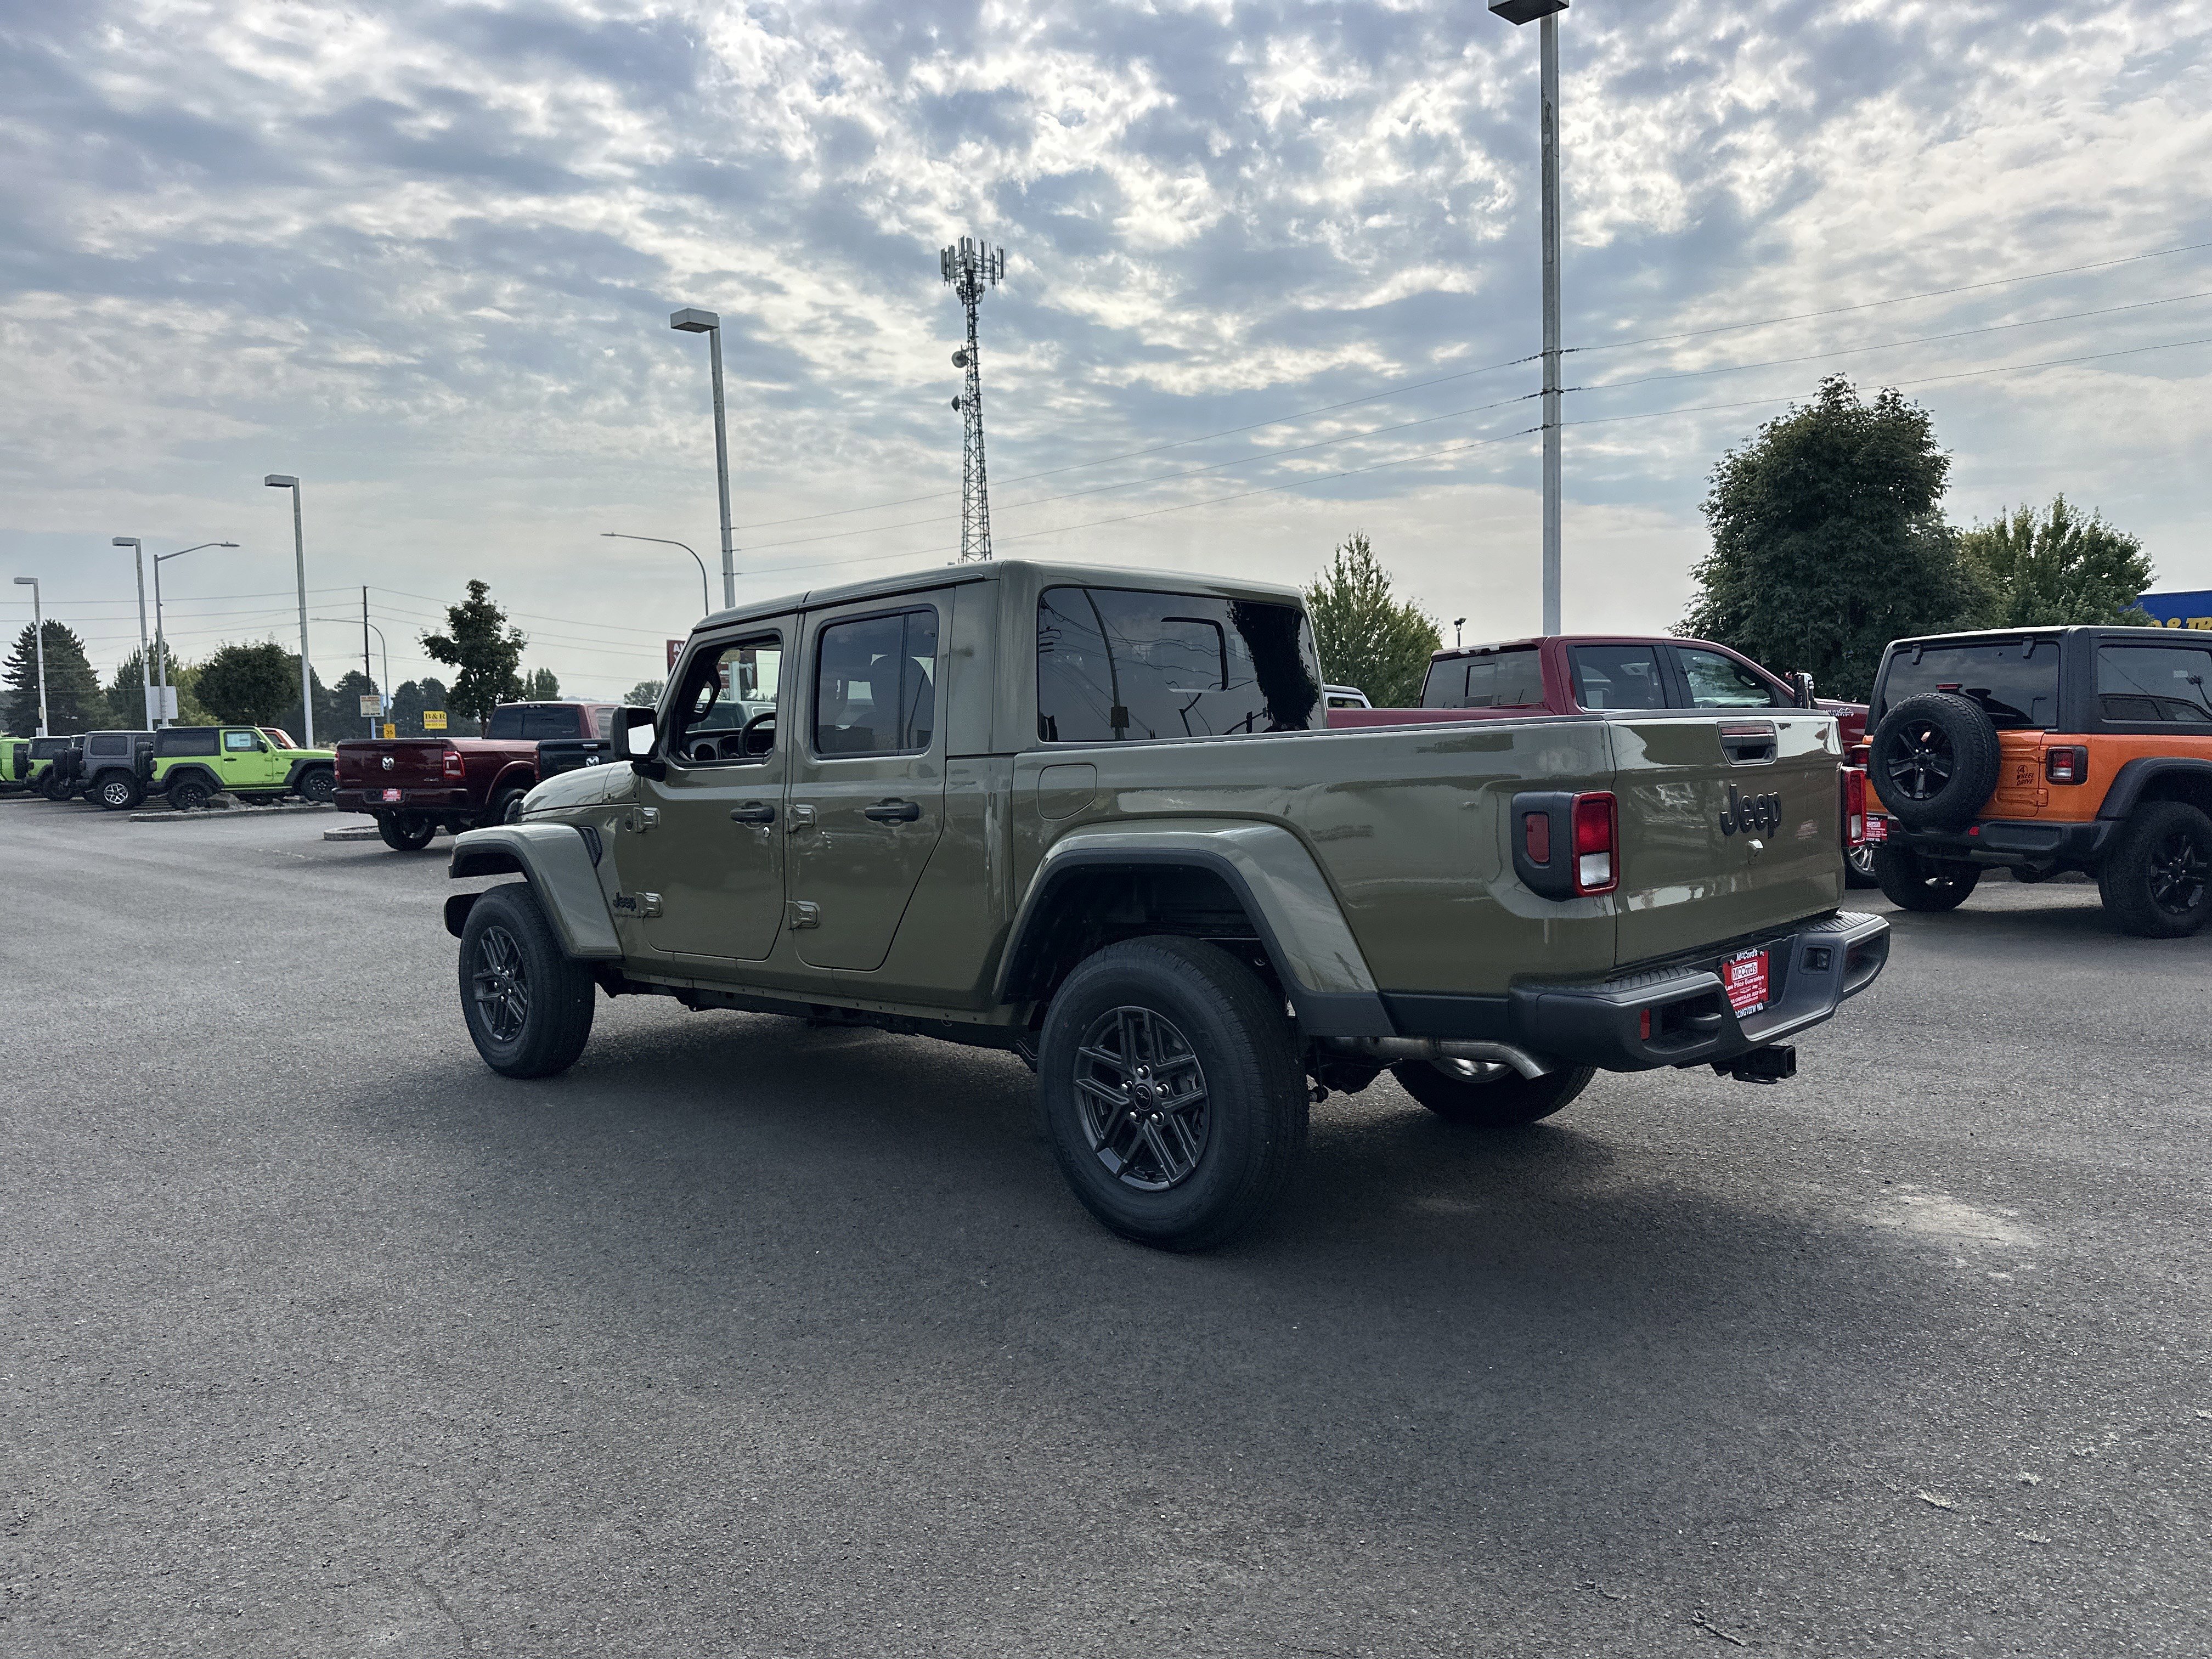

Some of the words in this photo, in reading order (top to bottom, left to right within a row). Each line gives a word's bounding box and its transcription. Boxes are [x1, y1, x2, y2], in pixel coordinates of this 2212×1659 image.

[1719, 784, 1782, 839] Jeep
[613, 892, 636, 911] Jeep
[1736, 949, 1758, 961] McCord's
[1733, 964, 1756, 979] McCord's
[1735, 1005, 1756, 1018] LONGVIEW
